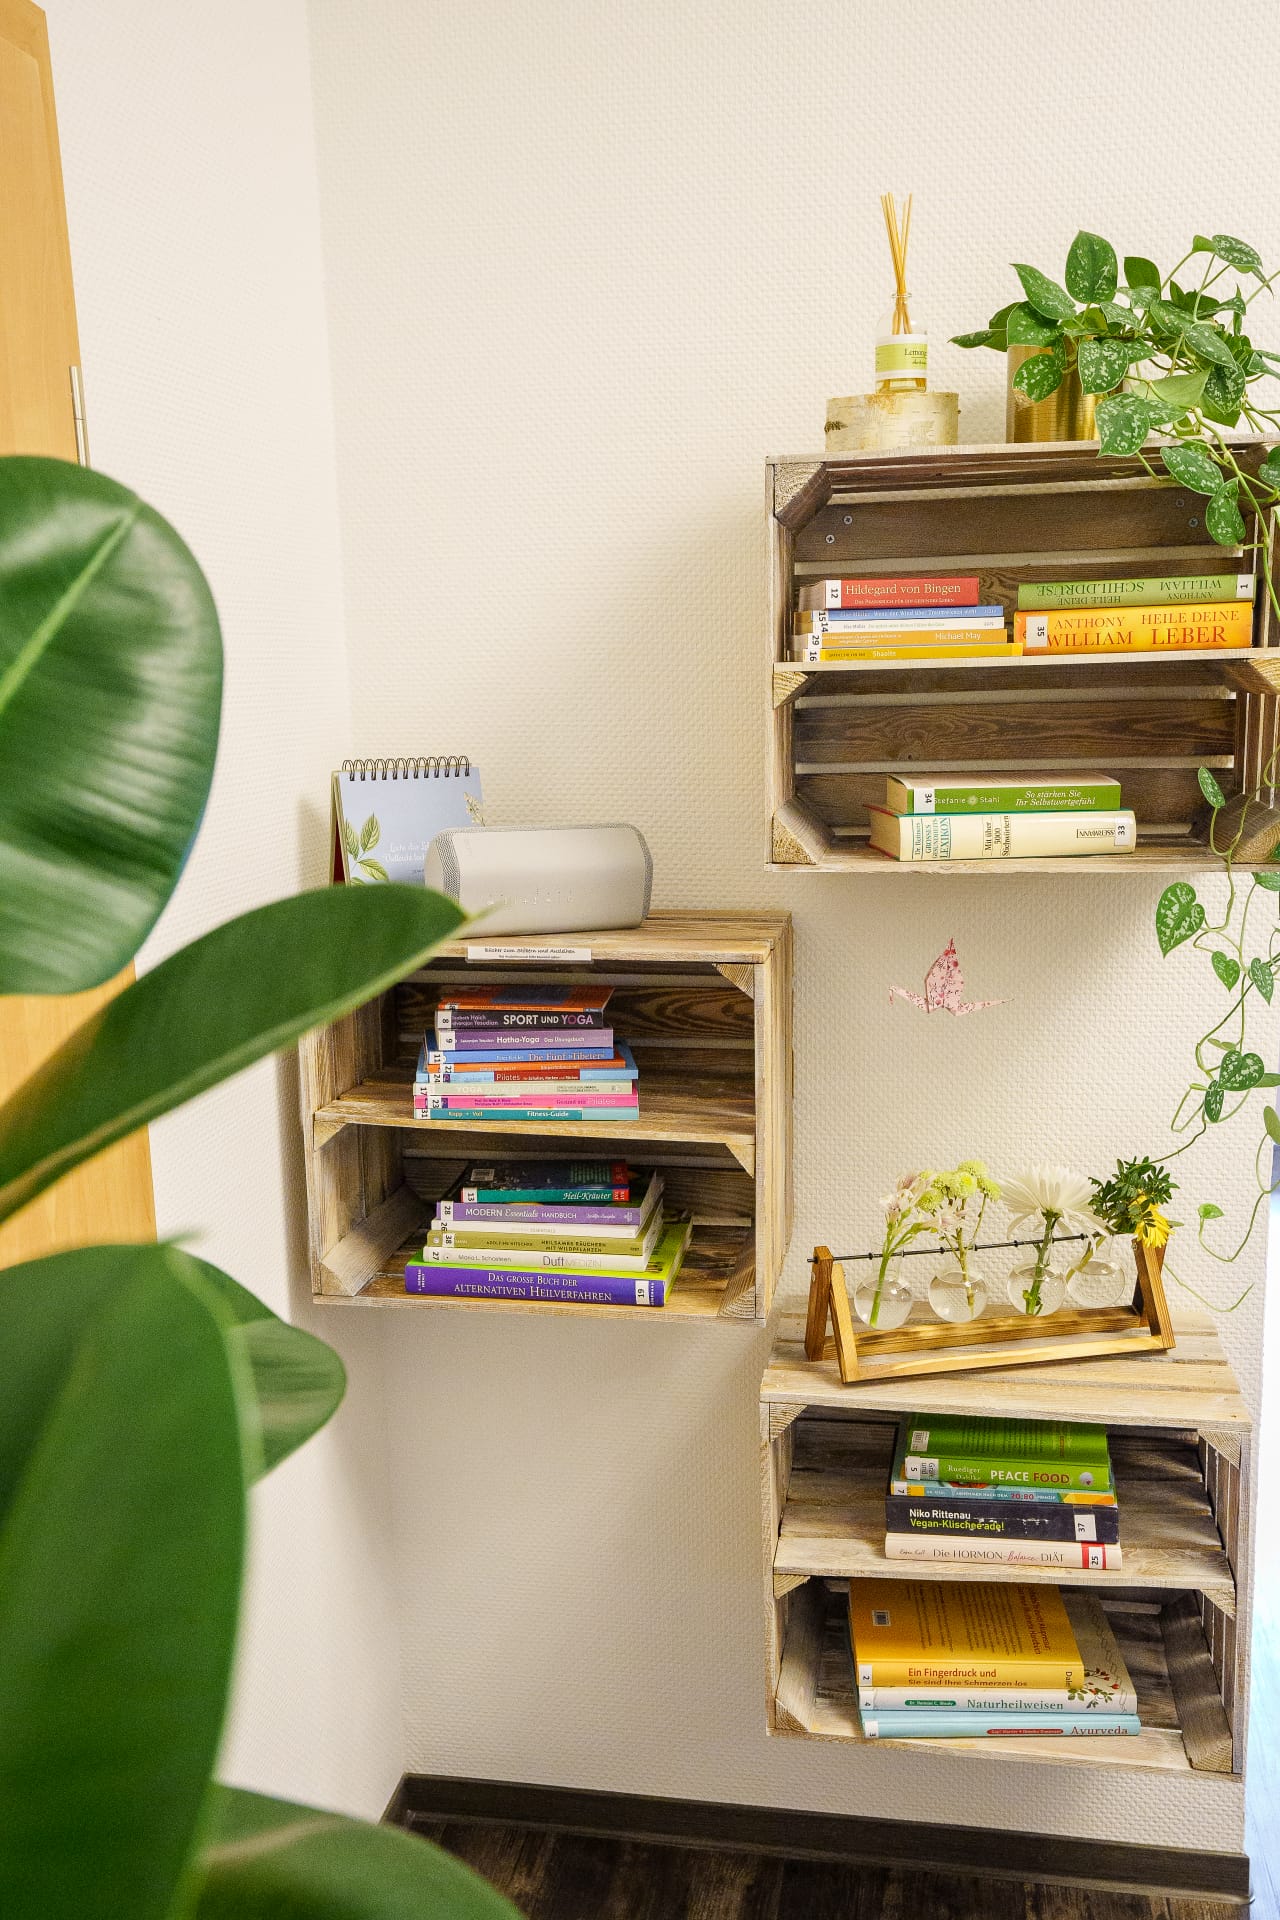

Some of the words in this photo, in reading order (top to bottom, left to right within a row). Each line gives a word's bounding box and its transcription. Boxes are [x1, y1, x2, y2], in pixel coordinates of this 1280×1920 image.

[846, 583, 896, 596] Hildegard
[900, 585, 920, 594] von
[924, 582, 961, 596] Bingen
[1037, 582, 1144, 596] SCHILDDRÜSE
[1160, 579, 1222, 591] WILLIAM
[830, 588, 839, 599] 12
[1167, 591, 1214, 600] ANTHONY
[1058, 597, 1088, 605] DEINE
[818, 610, 826, 622] 15
[1142, 612, 1189, 625] HEILE
[1193, 610, 1240, 623] DEINE
[821, 622, 828, 632] 14
[1054, 616, 1126, 630] ANTHONY
[935, 632, 964, 640] Michael
[966, 632, 981, 641] May
[1037, 626, 1044, 637] 35
[1152, 626, 1228, 645] LEBER
[812, 635, 820, 646] 29
[1048, 630, 1133, 646] WILLIAM
[809, 650, 817, 662] 16
[924, 792, 932, 804] 34
[1025, 790, 1036, 798] So
[1037, 790, 1067, 798] stärken
[1069, 790, 1080, 798] Sie
[980, 796, 1000, 804] Stahl
[1016, 798, 1028, 806] Ihr
[1030, 796, 1096, 806] Selbstwertgefühl
[984, 822, 992, 838] über
[1117, 826, 1126, 836] 33
[940, 816, 950, 858] LEXIKON
[1002, 815, 1010, 857] Stichwörtern
[984, 840, 992, 851] Mit
[503, 1014, 538, 1025] SPORT
[540, 1016, 559, 1024] UND
[561, 1014, 594, 1025] YOGA
[496, 1036, 540, 1044] Hatha-Yoga
[434, 1054, 440, 1062] 11
[546, 1052, 566, 1060] Fünf
[434, 1074, 440, 1083] 24
[420, 1087, 427, 1096] 17
[432, 1100, 440, 1108] 23
[422, 1109, 428, 1118] 31
[527, 1110, 569, 1118] Fitness-Guide
[467, 1192, 475, 1202] 13
[562, 1192, 612, 1200] Heil-Kräuter
[444, 1206, 452, 1215] 28
[465, 1208, 502, 1217] MODERN
[505, 1208, 538, 1218] Essentials
[440, 1222, 448, 1232] 26
[445, 1234, 452, 1244] 38
[432, 1251, 440, 1260] 27
[454, 1283, 526, 1297] ALTERNATIVEN
[530, 1285, 612, 1301] HEILVERFAHREN
[637, 1288, 644, 1298] 19
[947, 1464, 981, 1474] Ruediger
[990, 1470, 1029, 1482] PEACE
[1033, 1472, 1070, 1484] FOOD
[910, 1508, 930, 1518] Niko
[932, 1509, 970, 1521] Rittenau
[910, 1518, 982, 1530] Vegan-Klischee
[1078, 1522, 1086, 1533] 37
[934, 1548, 950, 1558] Die
[1092, 1556, 1099, 1566] 25
[908, 1668, 922, 1677] Ein
[924, 1668, 977, 1678] Fingerdruck
[981, 1668, 997, 1678] und
[967, 1700, 1064, 1710] Naturheilweisen
[1071, 1726, 1128, 1735] Ayurveda
